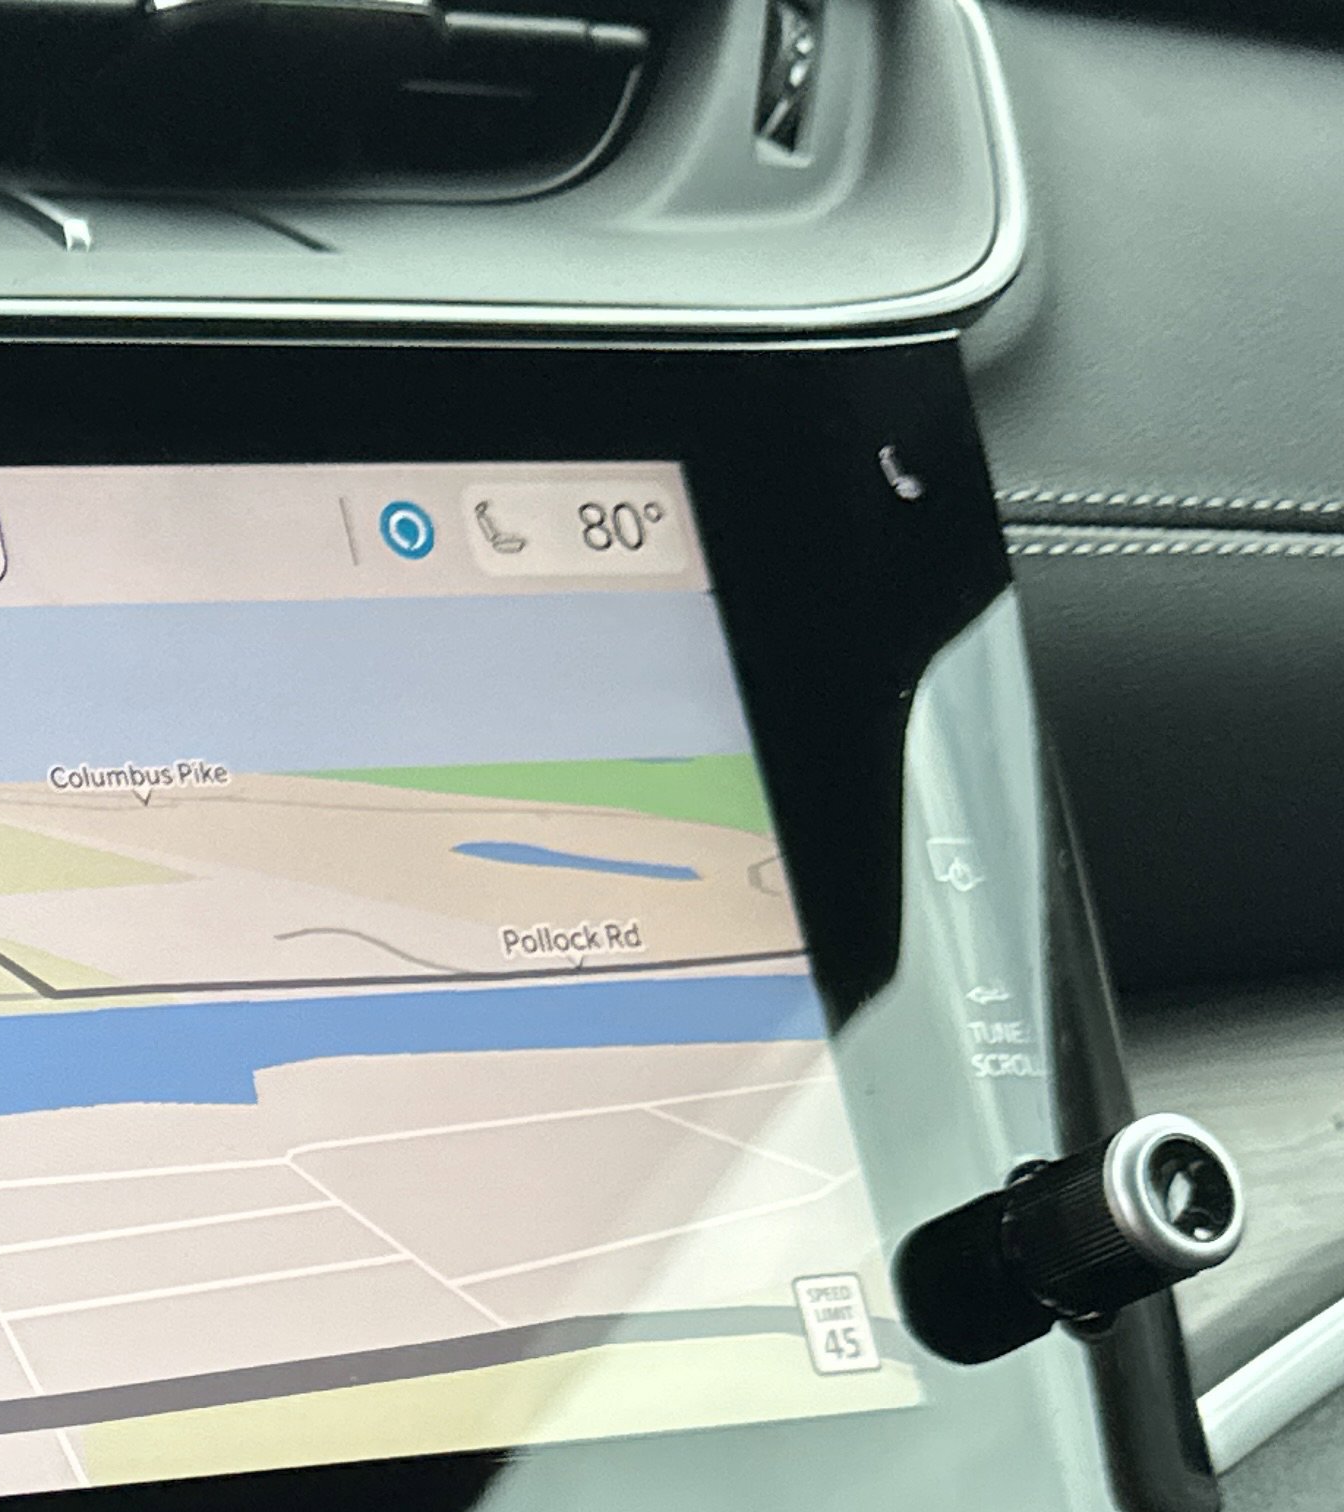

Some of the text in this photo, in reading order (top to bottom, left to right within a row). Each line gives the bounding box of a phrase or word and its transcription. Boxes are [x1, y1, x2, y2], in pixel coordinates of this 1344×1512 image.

[577, 500, 665, 552] 80°
[49, 760, 229, 789] Columbus Pike
[502, 922, 643, 955] Pollock Rd
[825, 1326, 862, 1359] 45
